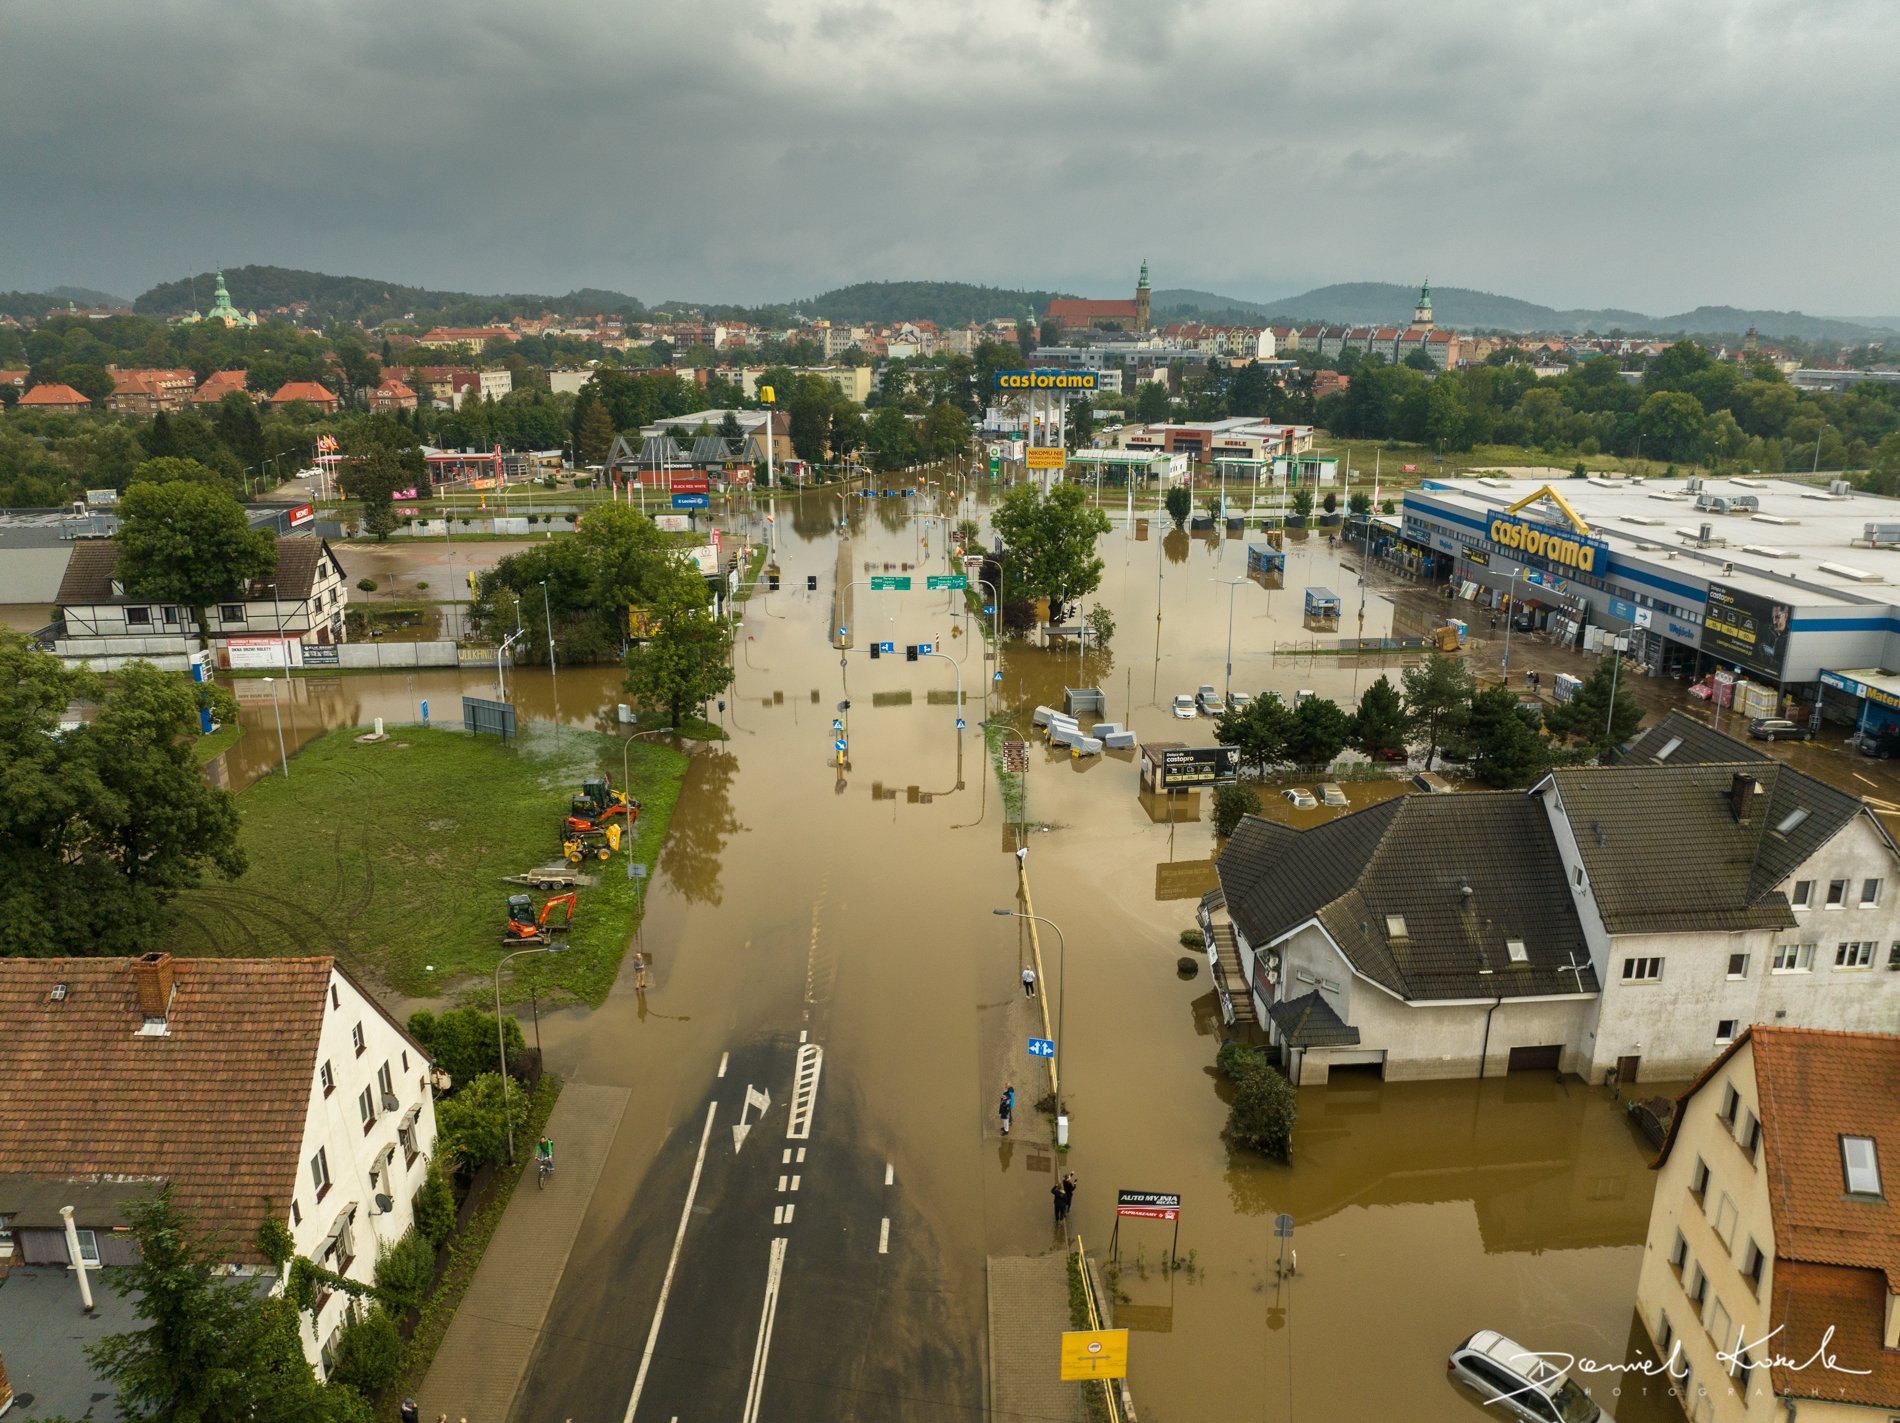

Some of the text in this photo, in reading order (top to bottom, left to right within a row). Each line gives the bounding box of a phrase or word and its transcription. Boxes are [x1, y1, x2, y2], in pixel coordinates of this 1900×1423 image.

[1000, 373, 1094, 388] castorama
[1490, 519, 1595, 572] castorama
[1709, 591, 1734, 604] castopro
